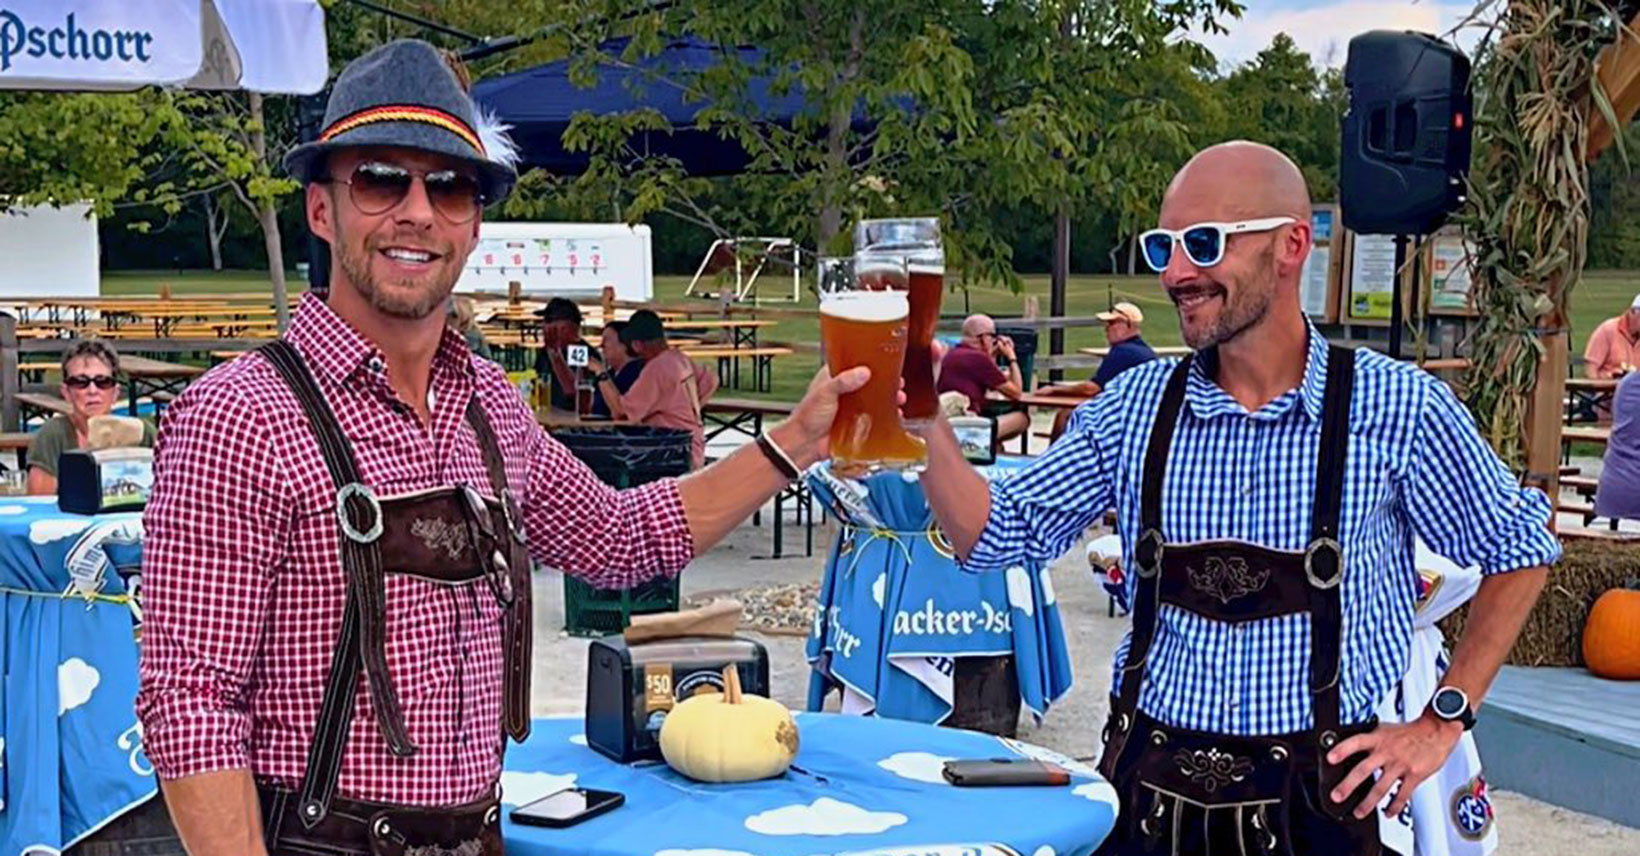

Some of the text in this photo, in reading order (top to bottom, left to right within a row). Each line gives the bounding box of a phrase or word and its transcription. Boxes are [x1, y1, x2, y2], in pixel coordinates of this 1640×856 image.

[0, 9, 153, 71] Pschorr
[570, 348, 586, 362] 42
[646, 674, 670, 694] $50
